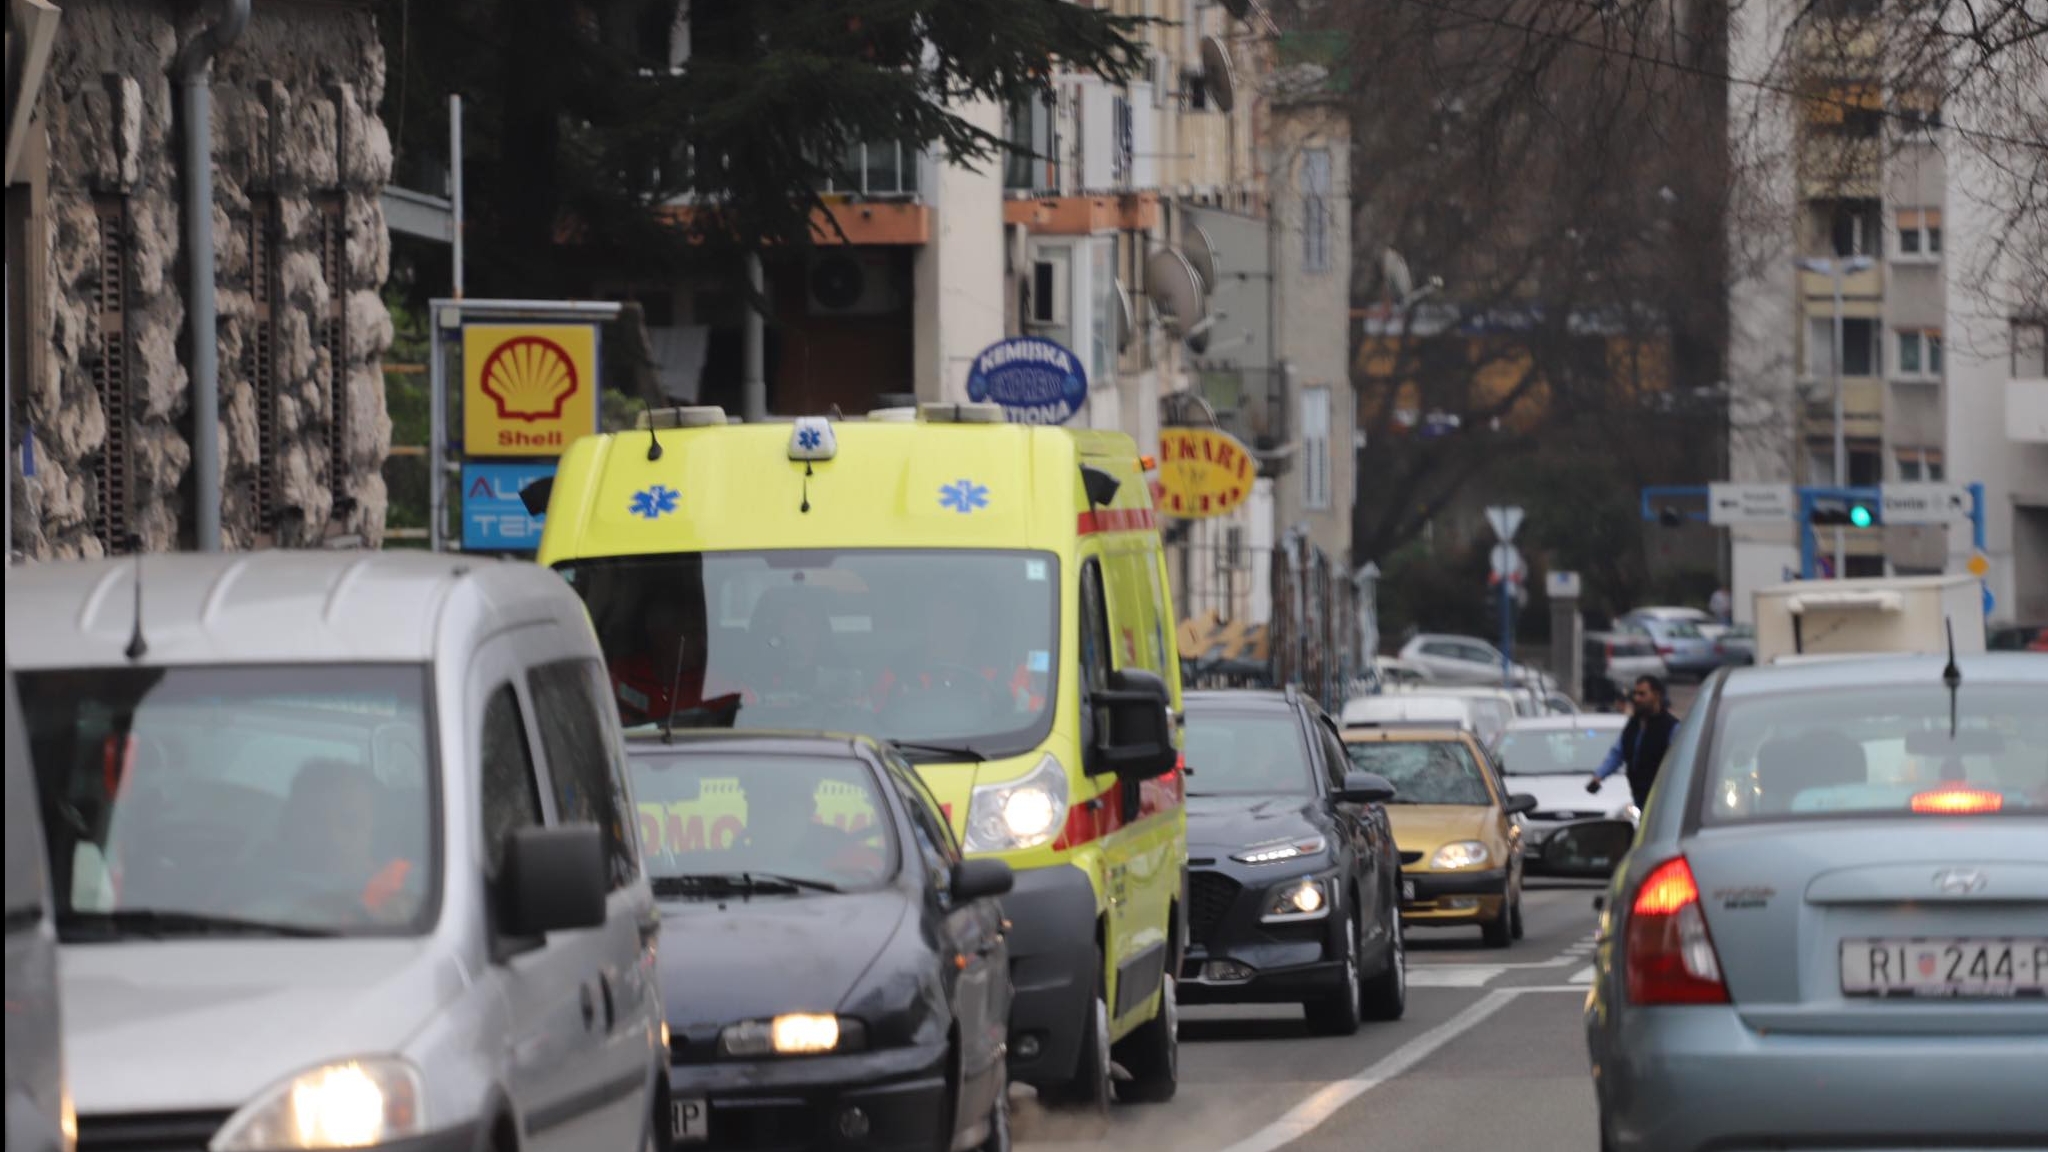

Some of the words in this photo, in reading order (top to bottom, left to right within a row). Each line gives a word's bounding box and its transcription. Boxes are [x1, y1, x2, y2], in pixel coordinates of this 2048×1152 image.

[980, 340, 1073, 374] KEMIJSKA
[498, 430, 563, 446] Shell
[1869, 946, 1906, 985] RI
